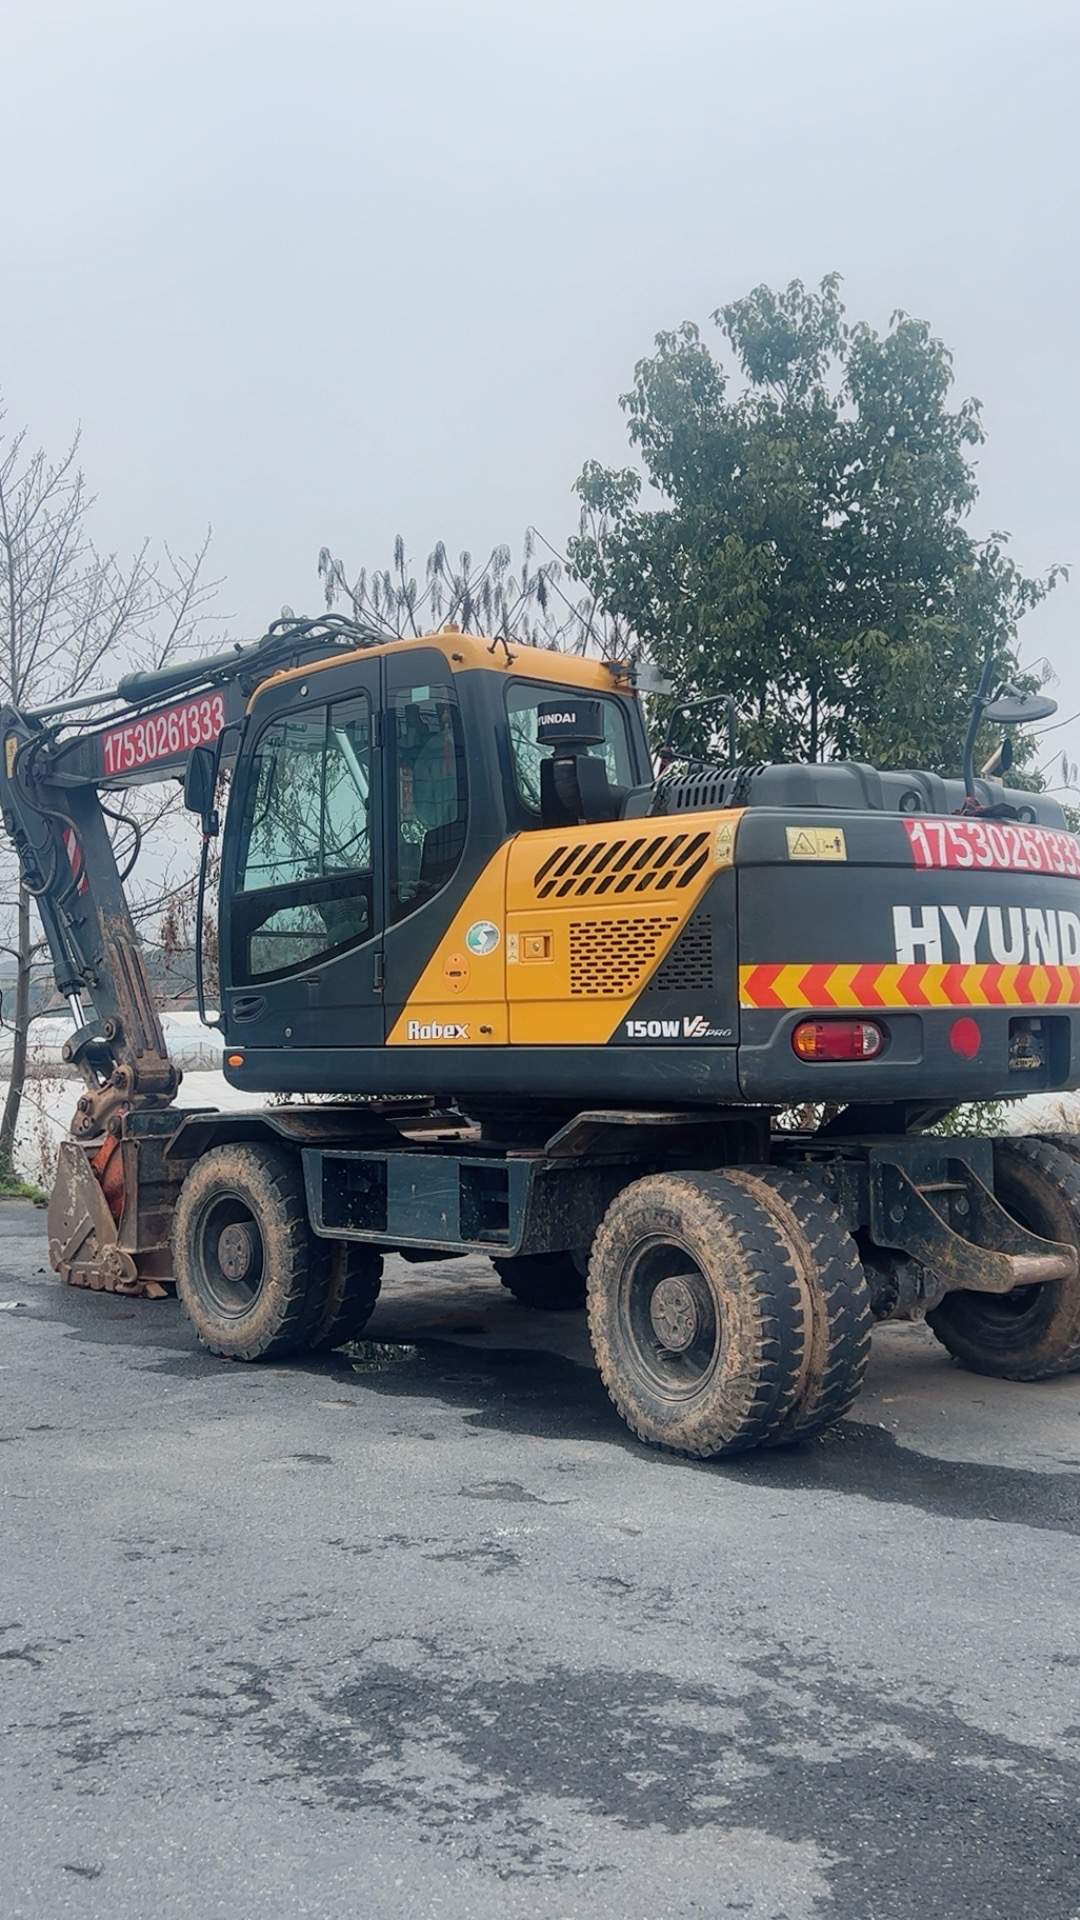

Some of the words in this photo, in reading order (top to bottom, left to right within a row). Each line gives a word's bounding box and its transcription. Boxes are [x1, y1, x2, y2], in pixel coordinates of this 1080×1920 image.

[104, 696, 225, 772] 17530261333
[408, 1020, 470, 1040] Robex
[625, 1020, 681, 1038] 150W
